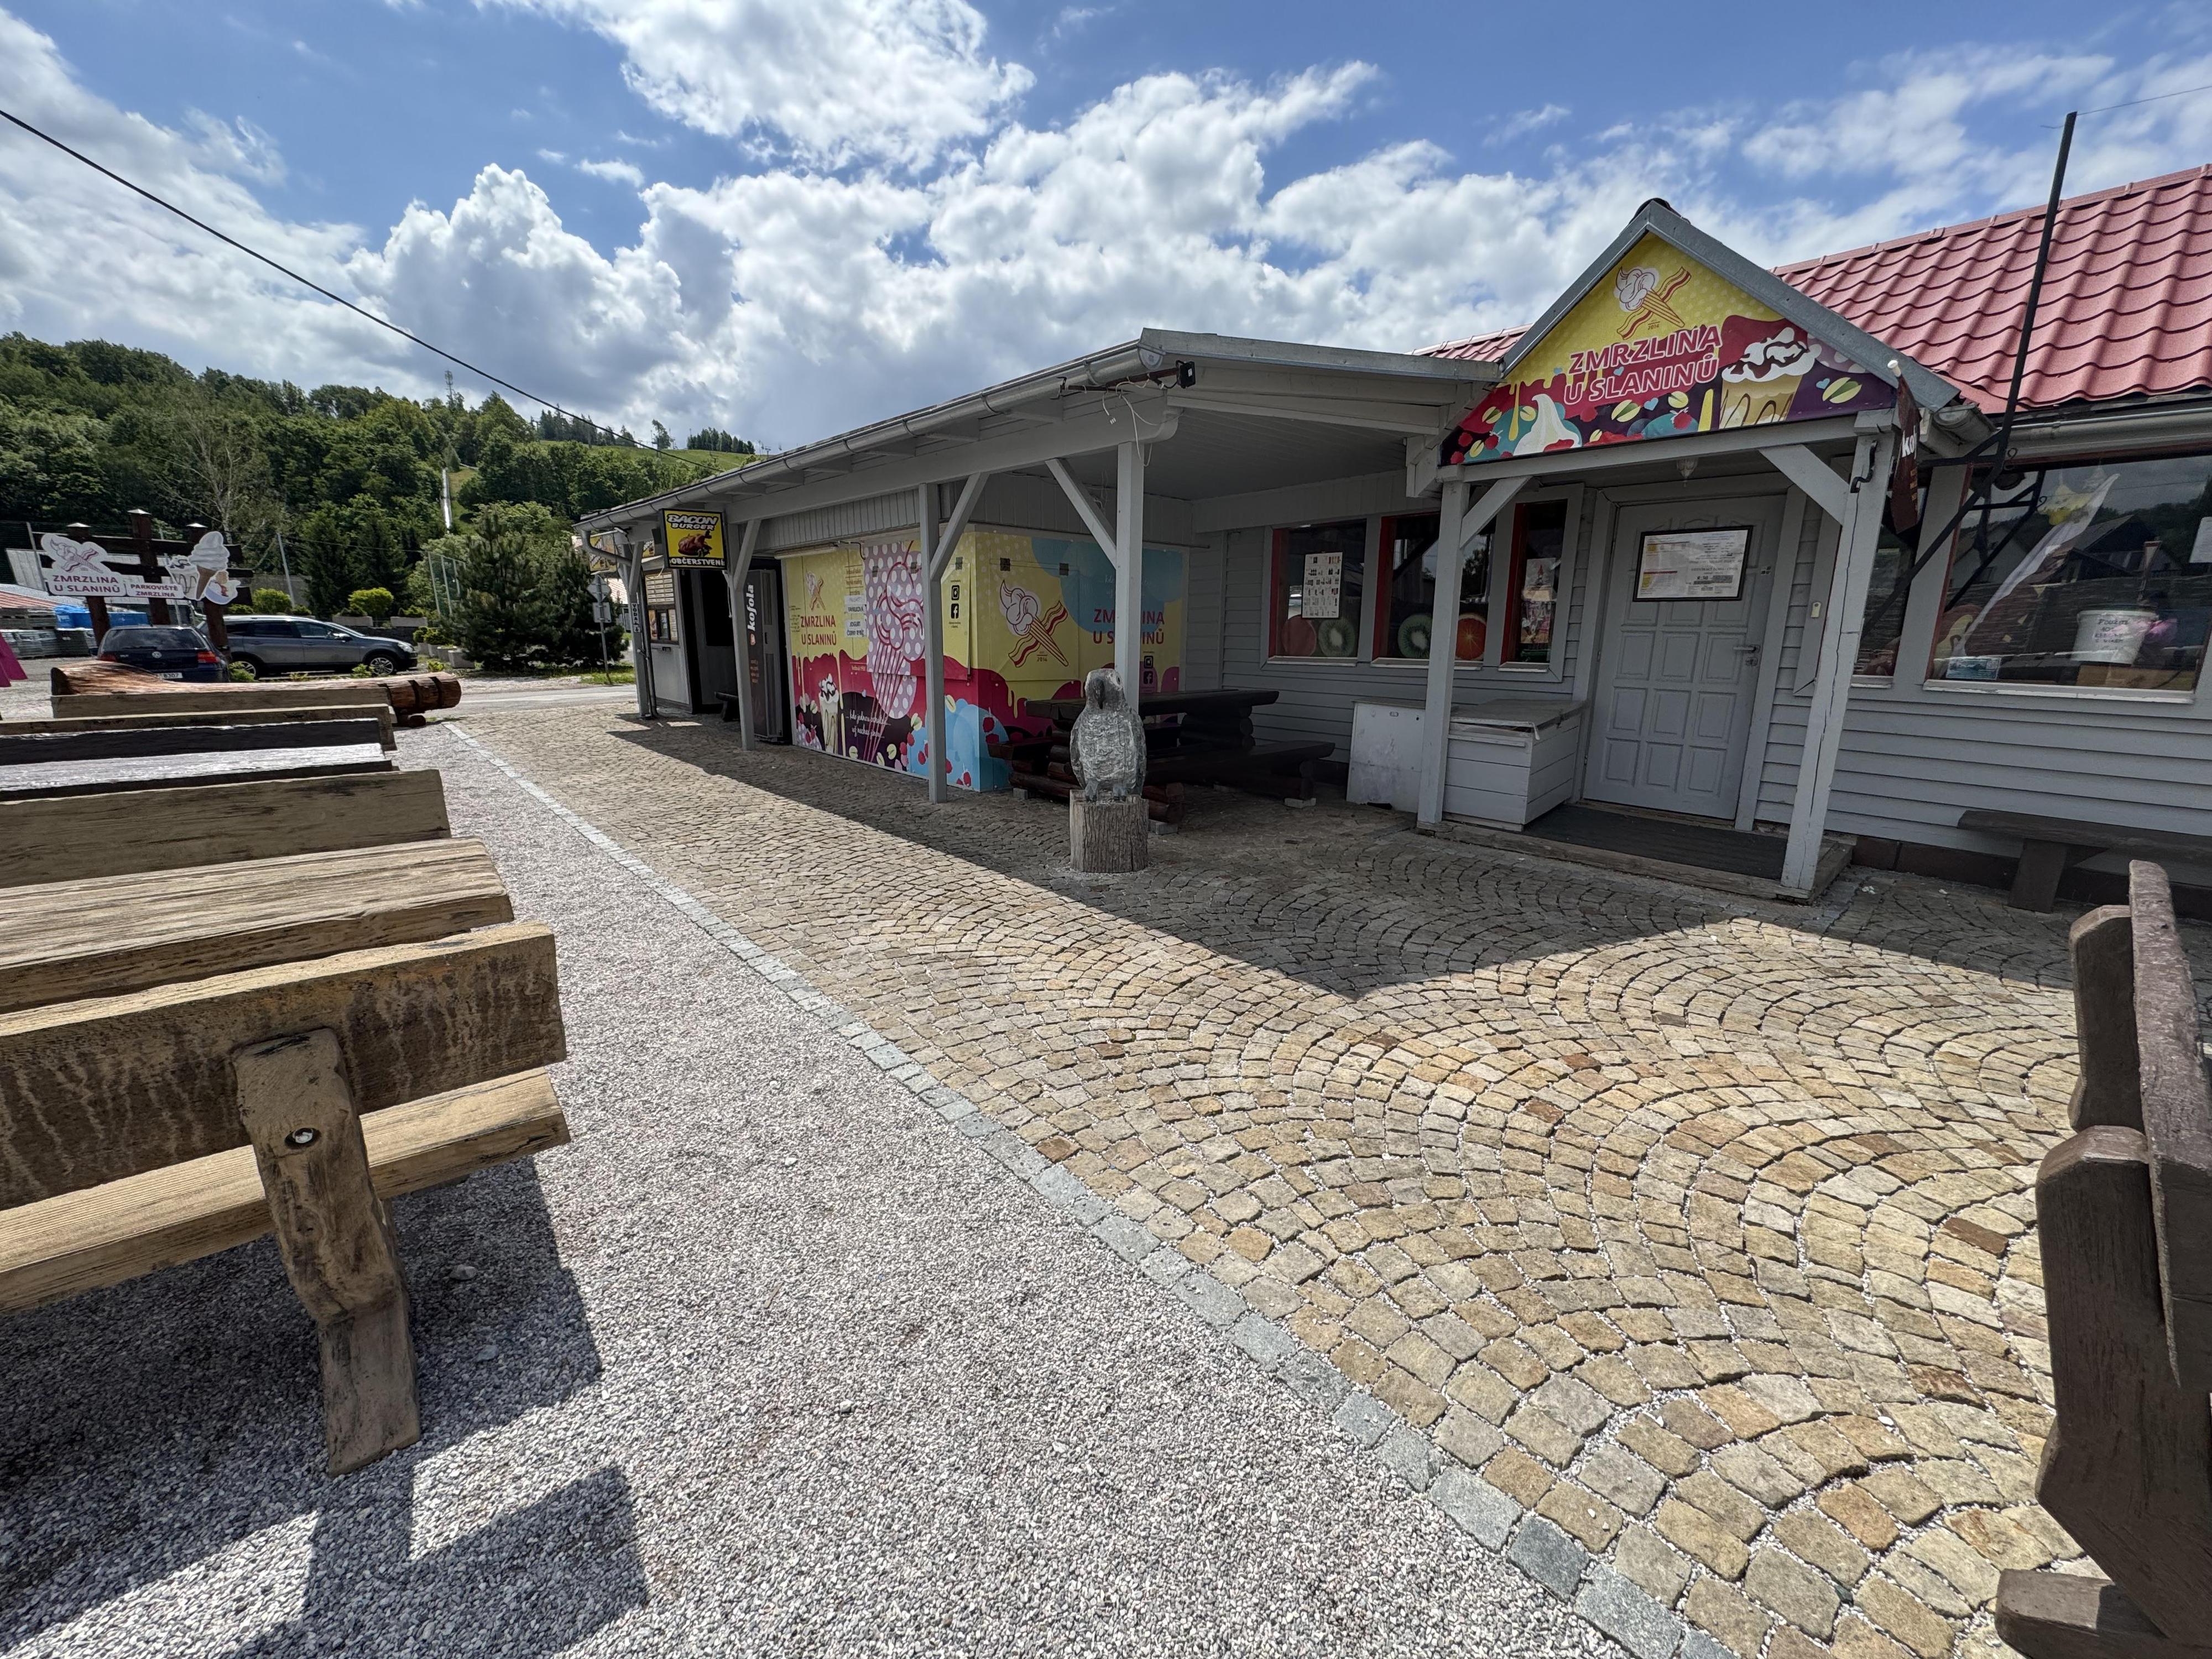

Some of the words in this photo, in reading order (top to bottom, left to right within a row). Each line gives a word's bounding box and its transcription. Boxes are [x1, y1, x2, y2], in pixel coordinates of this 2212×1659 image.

[1568, 324, 1722, 375] ZMRZLINA
[1564, 382, 1583, 405] U
[1589, 353, 1719, 401] SLANINŮ
[667, 514, 718, 525] BACON
[671, 557, 725, 566] OBČERSTVENÍ
[53, 575, 118, 583] ZMRZLINA
[67, 585, 120, 593] SLANINŮ
[746, 585, 757, 631] kofola
[800, 615, 836, 628] ZMRZLINA
[1094, 609, 1165, 625] ZMINA
[801, 634, 806, 645] U
[807, 631, 837, 645] SLANINŮ
[1093, 630, 1102, 644] U
[1107, 628, 1164, 644] SINŮ
